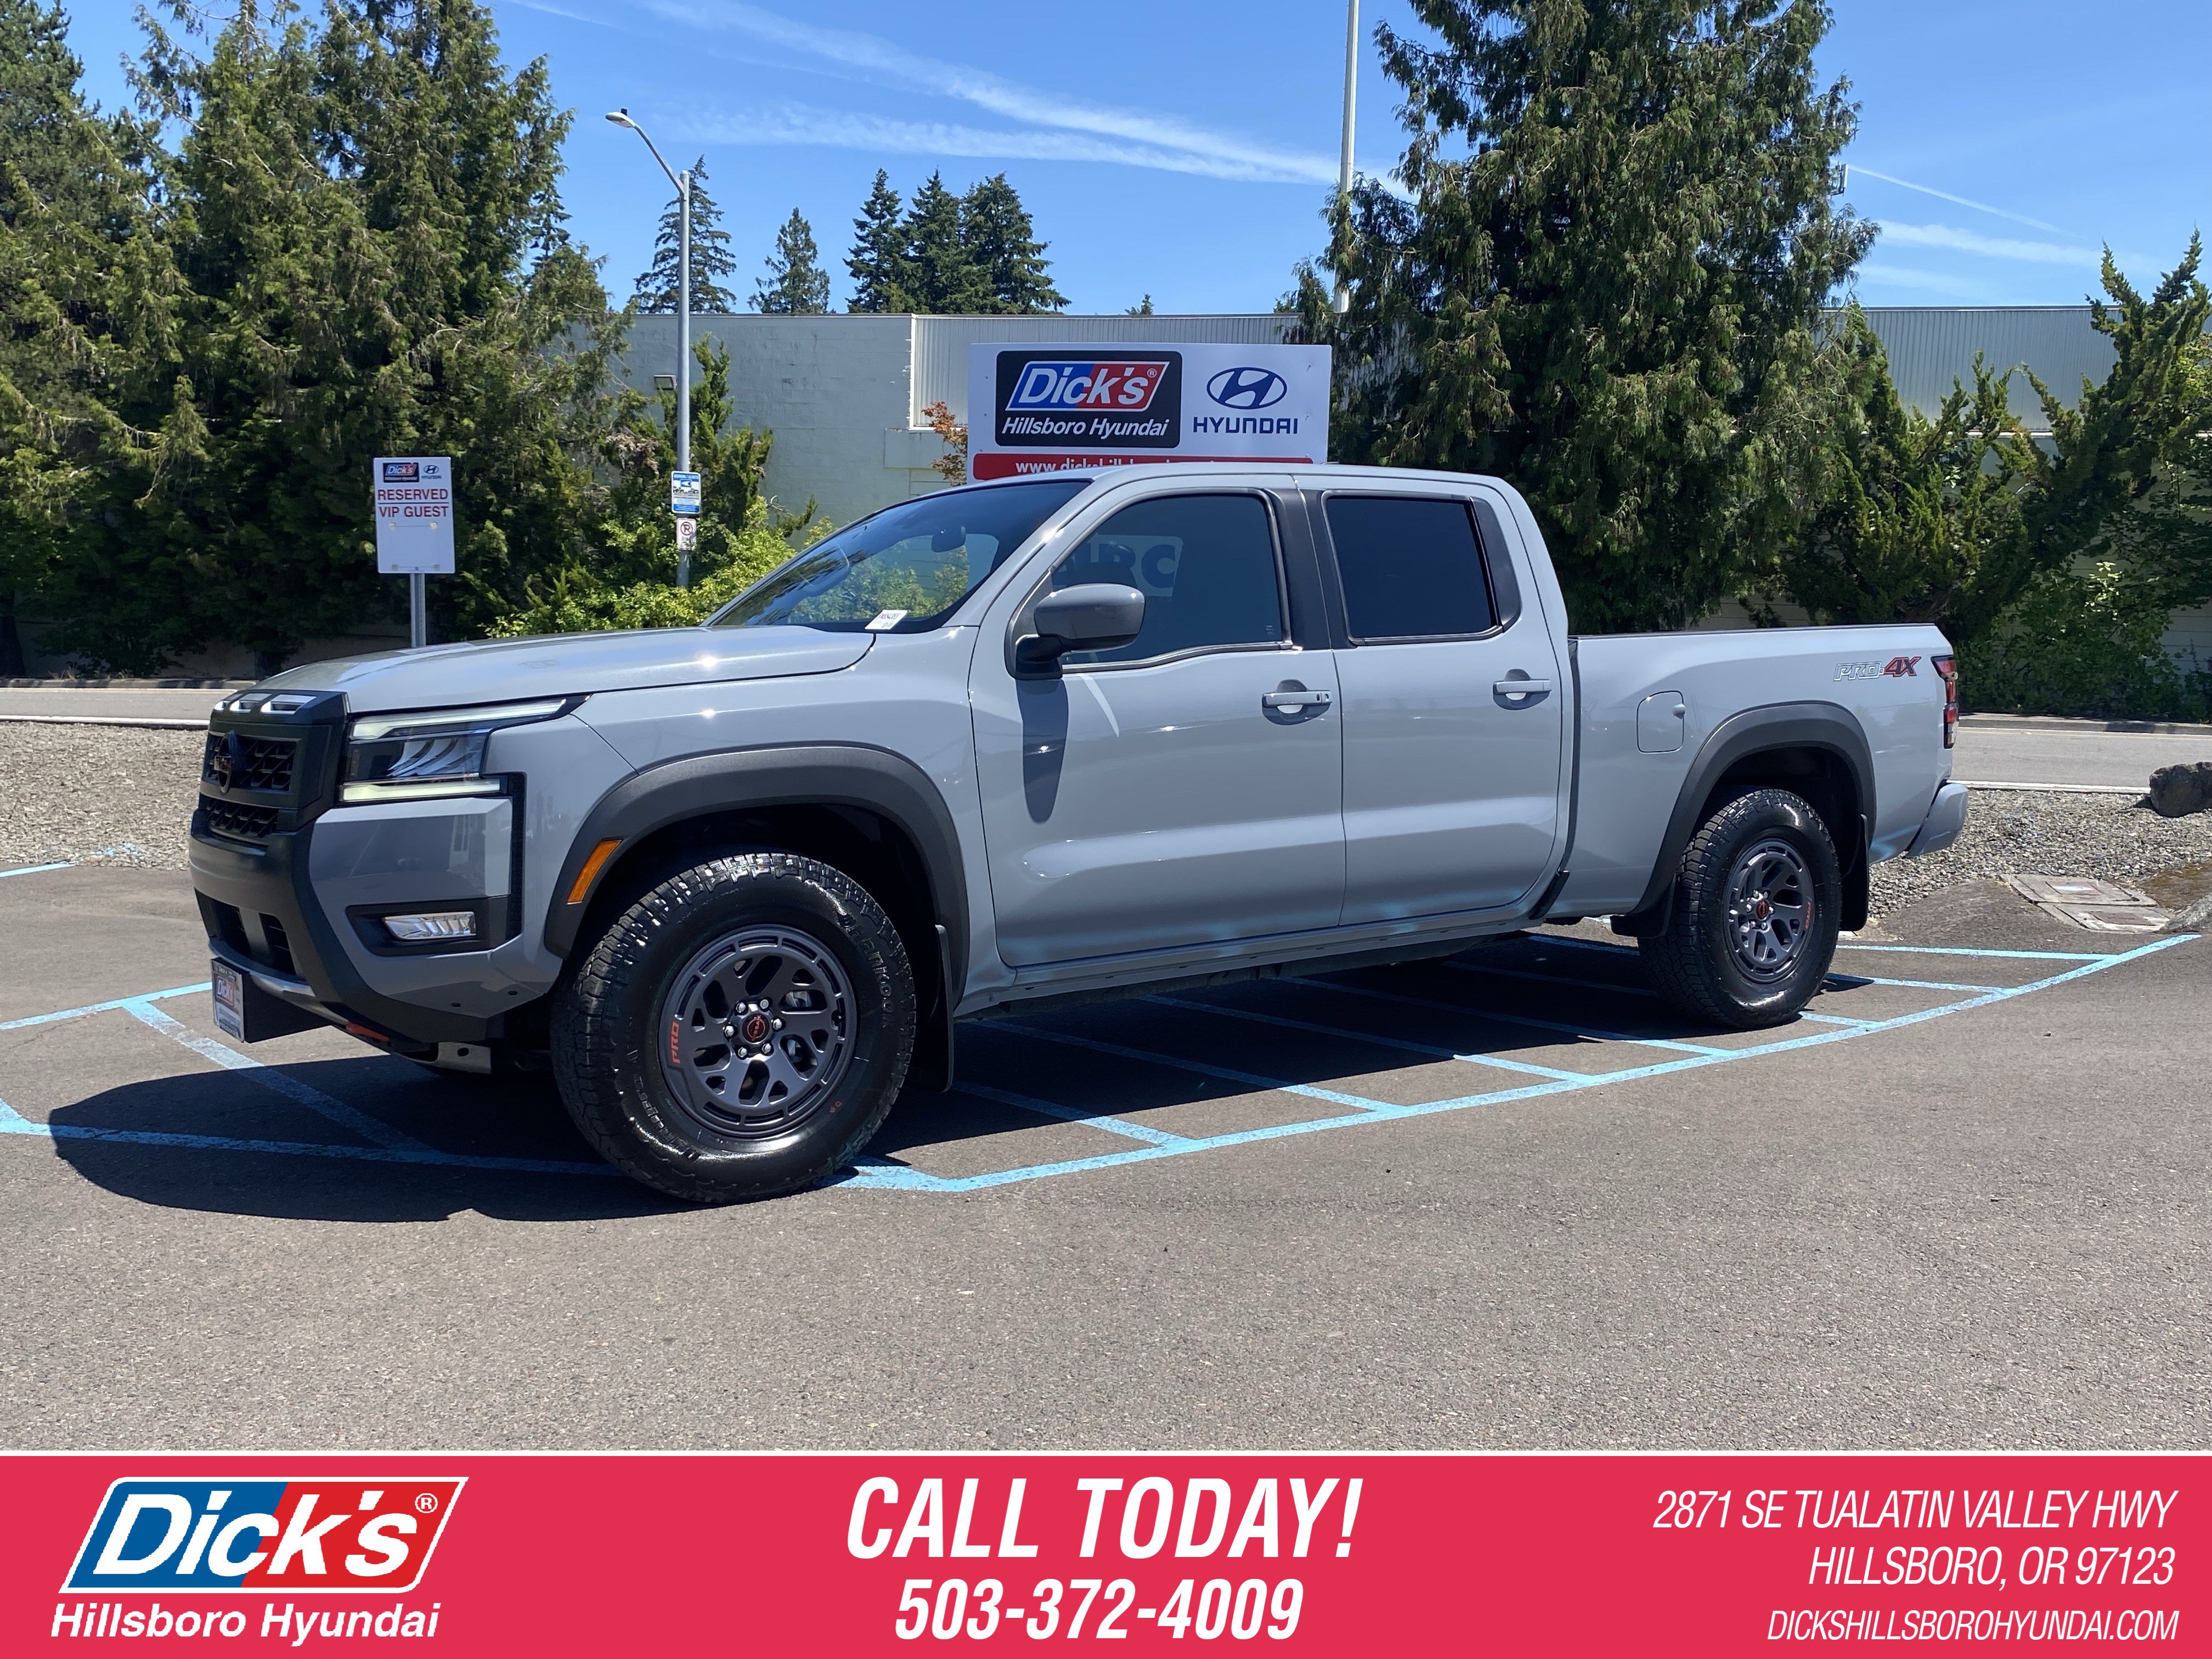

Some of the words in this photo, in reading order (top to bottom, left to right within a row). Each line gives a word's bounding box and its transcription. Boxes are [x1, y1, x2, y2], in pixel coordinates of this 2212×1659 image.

[1002, 417, 1086, 435] Hillsboro
[1089, 418, 1170, 439] Hyundai
[1193, 417, 1298, 434] HYUNDAI
[377, 488, 449, 500] RESERVED
[379, 506, 399, 517] VIP
[404, 506, 449, 517] GUEST
[670, 1020, 681, 1064] PRO
